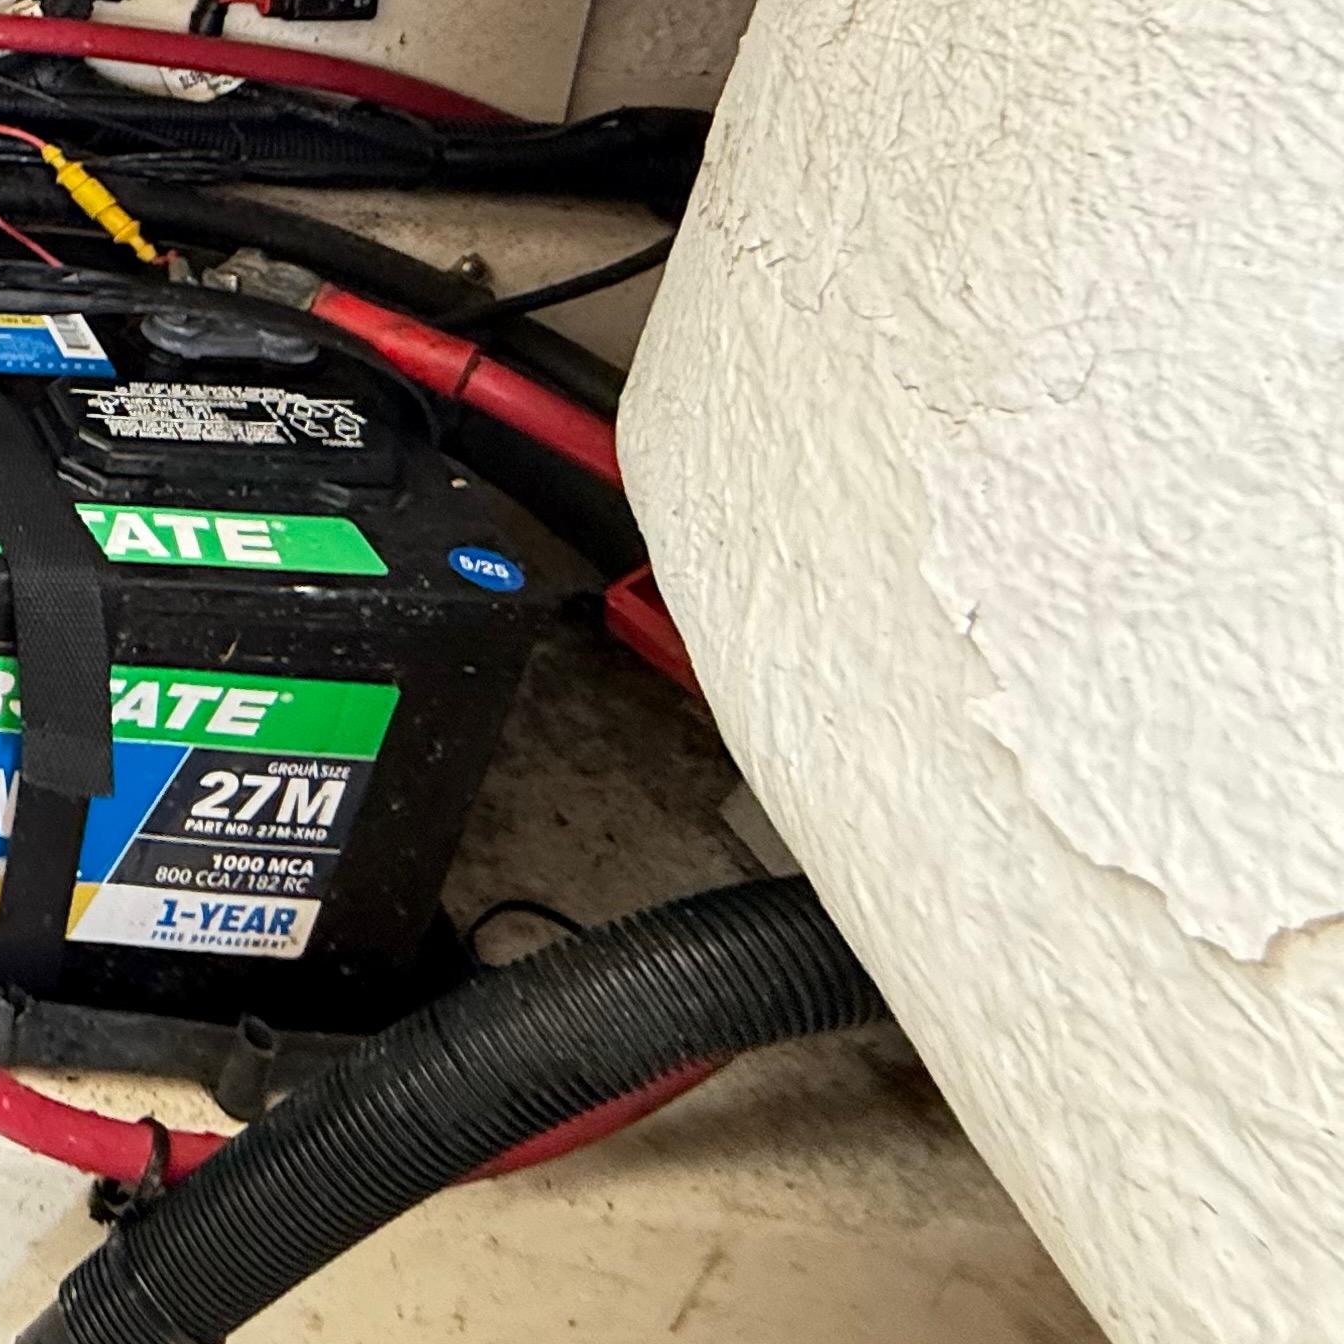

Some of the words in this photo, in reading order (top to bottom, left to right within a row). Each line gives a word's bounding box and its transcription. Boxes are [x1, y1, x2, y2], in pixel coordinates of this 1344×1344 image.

[191, 771, 346, 827] 27M
[185, 818, 222, 834] PART
[225, 821, 253, 837] NO:
[256, 825, 328, 841] 27M-XHD
[155, 865, 191, 884] 800
[195, 869, 230, 888] CCA
[248, 874, 280, 891] 182
[283, 877, 311, 894] RC
[213, 854, 264, 872] 1000
[268, 857, 313, 876] MCA
[156, 899, 298, 936] 1-YEAR
